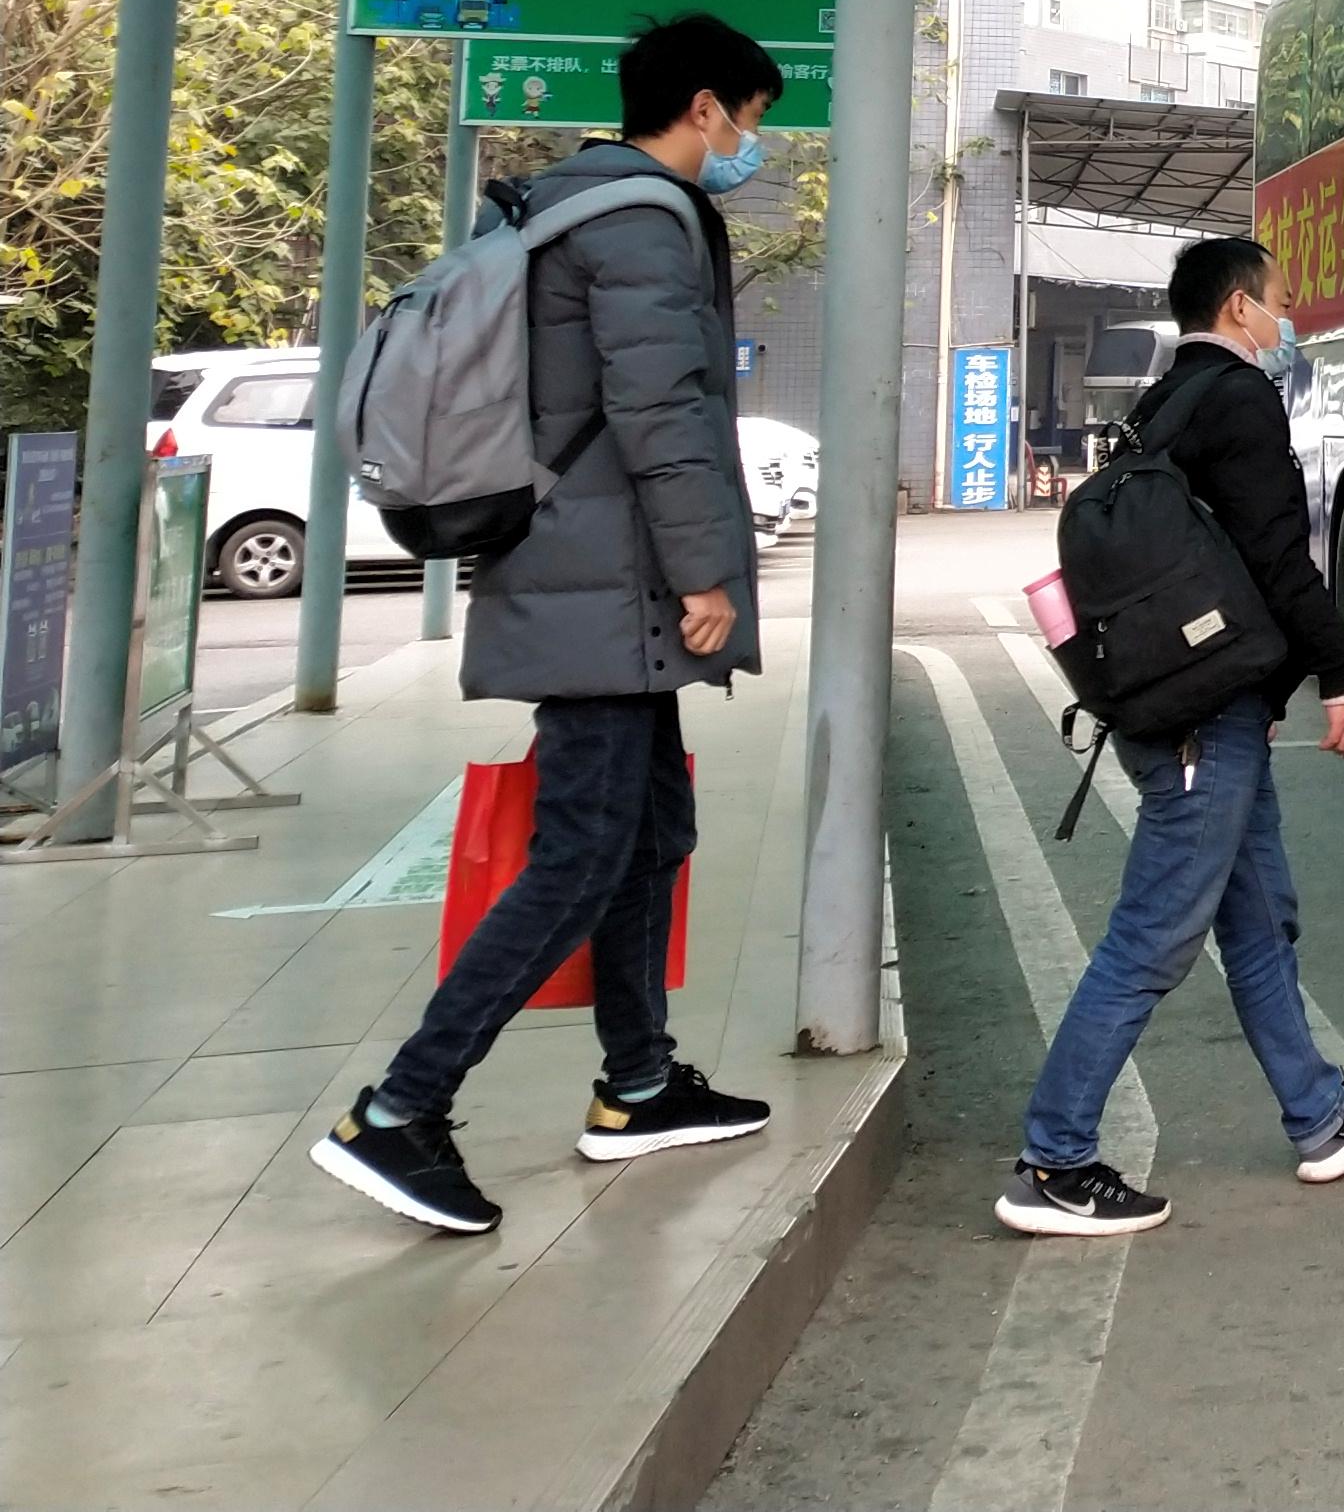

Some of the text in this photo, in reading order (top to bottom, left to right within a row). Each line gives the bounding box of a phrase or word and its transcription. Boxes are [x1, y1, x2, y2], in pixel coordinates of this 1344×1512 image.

[961, 354, 998, 506] 车检场地 行人止步
